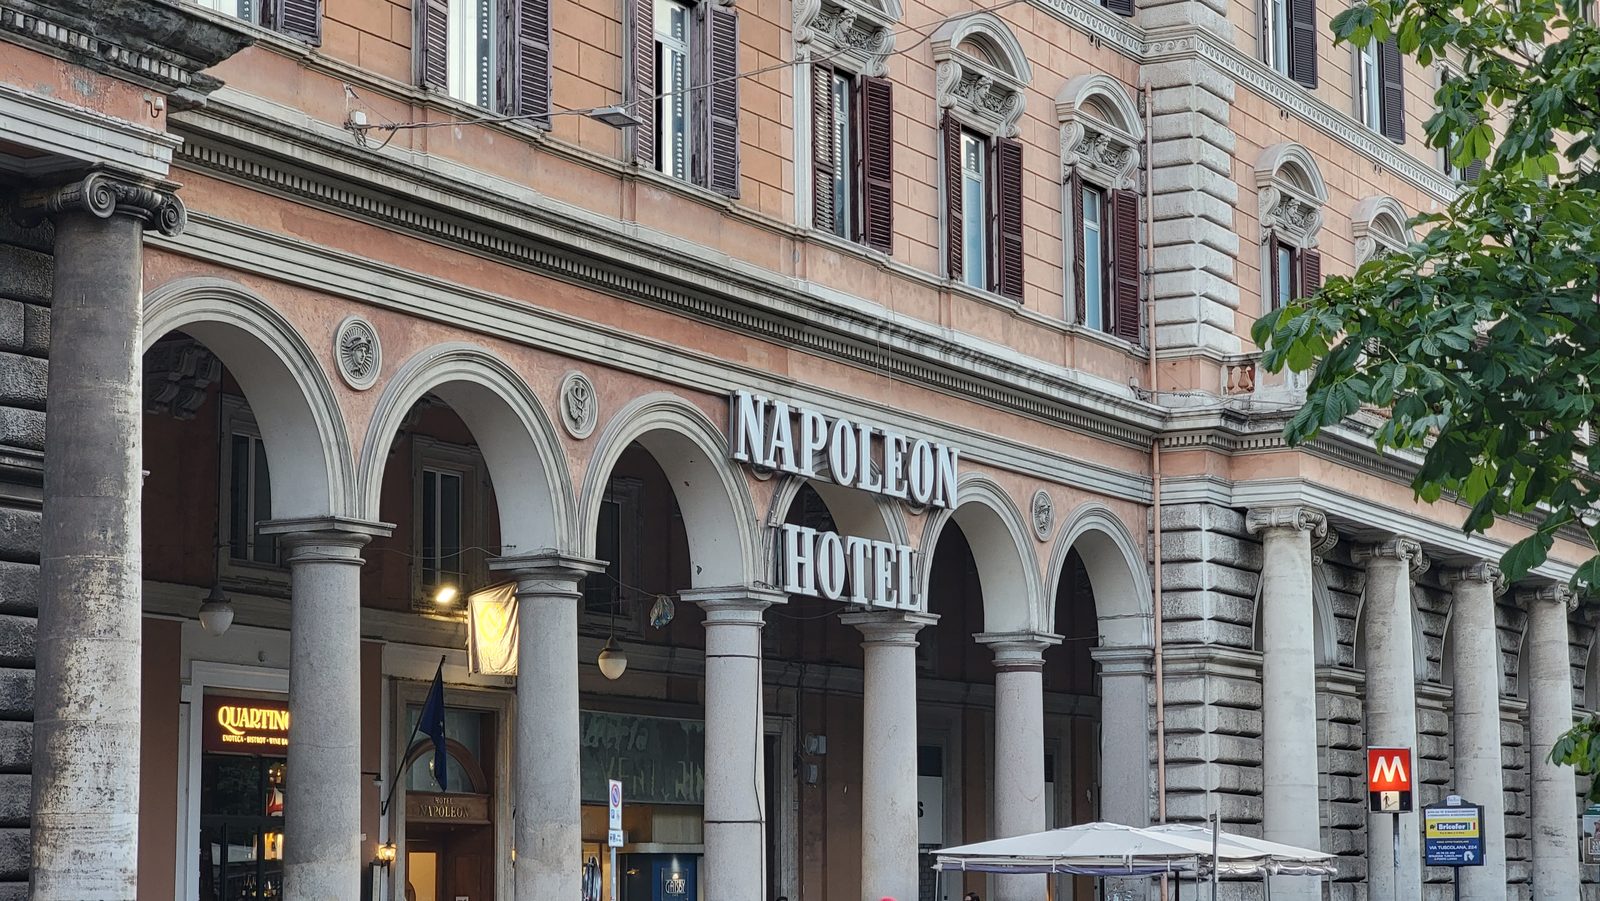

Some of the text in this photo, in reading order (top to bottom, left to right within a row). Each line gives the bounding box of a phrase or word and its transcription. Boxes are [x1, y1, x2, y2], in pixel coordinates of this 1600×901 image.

[732, 389, 960, 510] NAPOLEON
[782, 523, 921, 612] HOTEL
[1372, 756, 1408, 783] M
[419, 804, 470, 818] NAPOLEON
